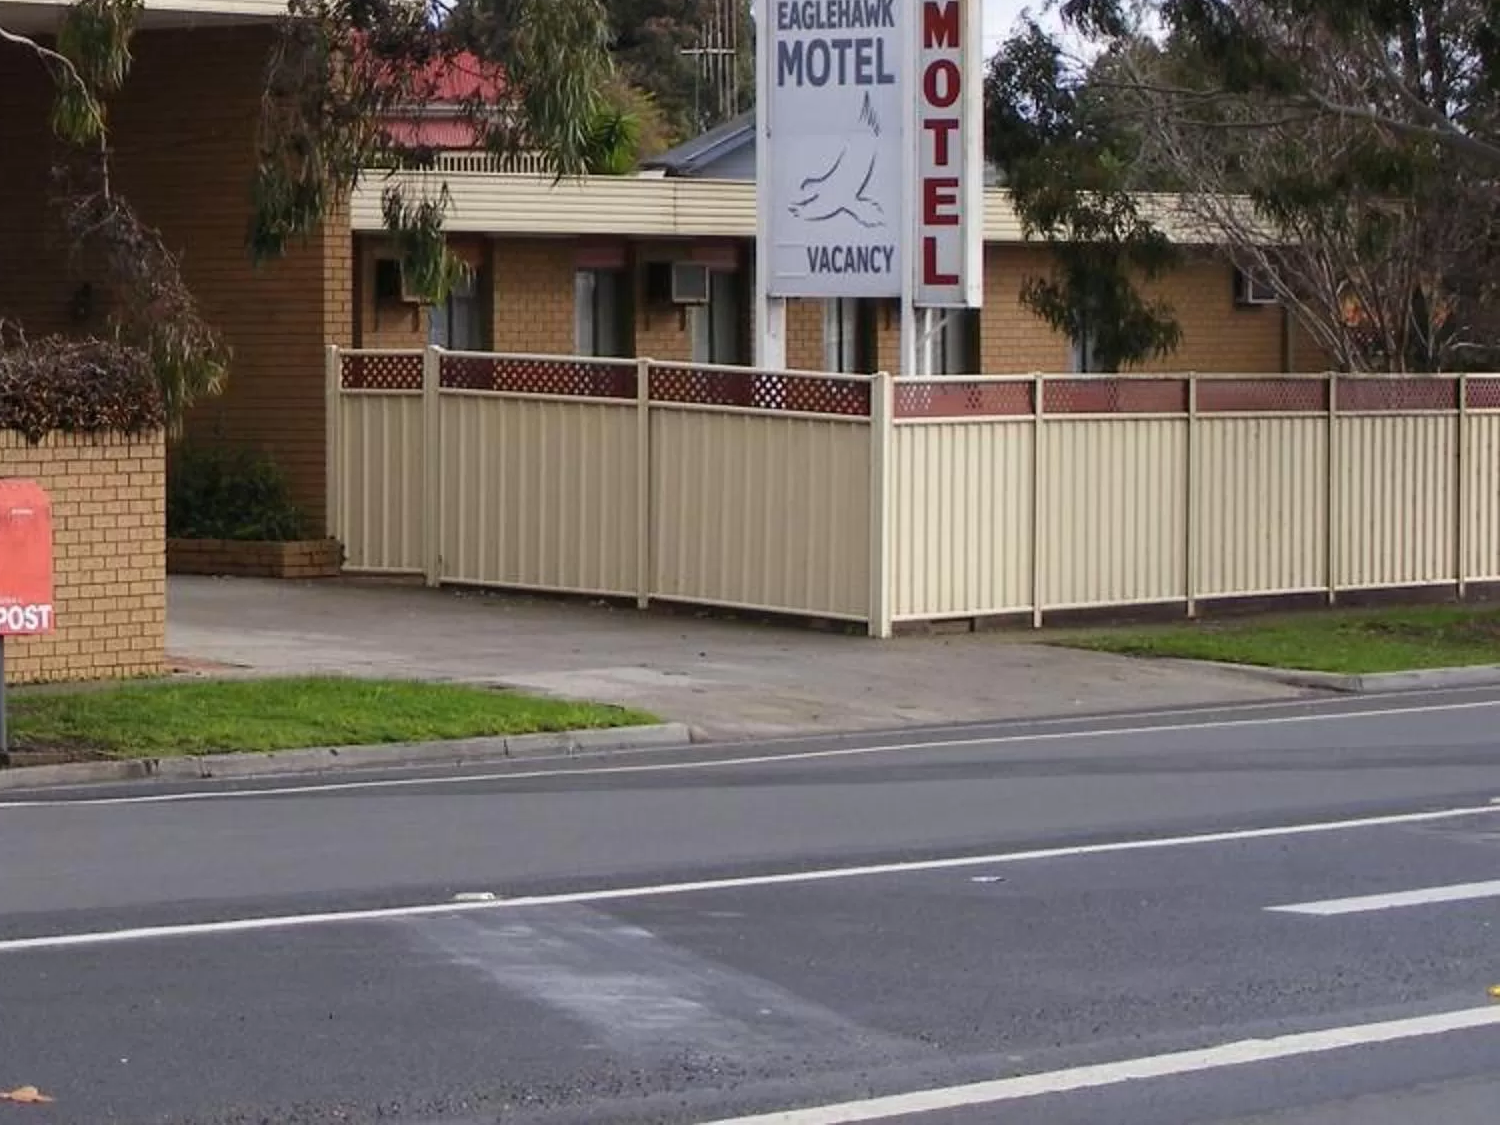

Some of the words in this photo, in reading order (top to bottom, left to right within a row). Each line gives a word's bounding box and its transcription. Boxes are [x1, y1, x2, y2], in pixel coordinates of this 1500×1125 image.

[777, 38, 896, 87] MOTEL
[922, 0, 962, 286] MOTEL
[807, 245, 895, 274] VACANCY
